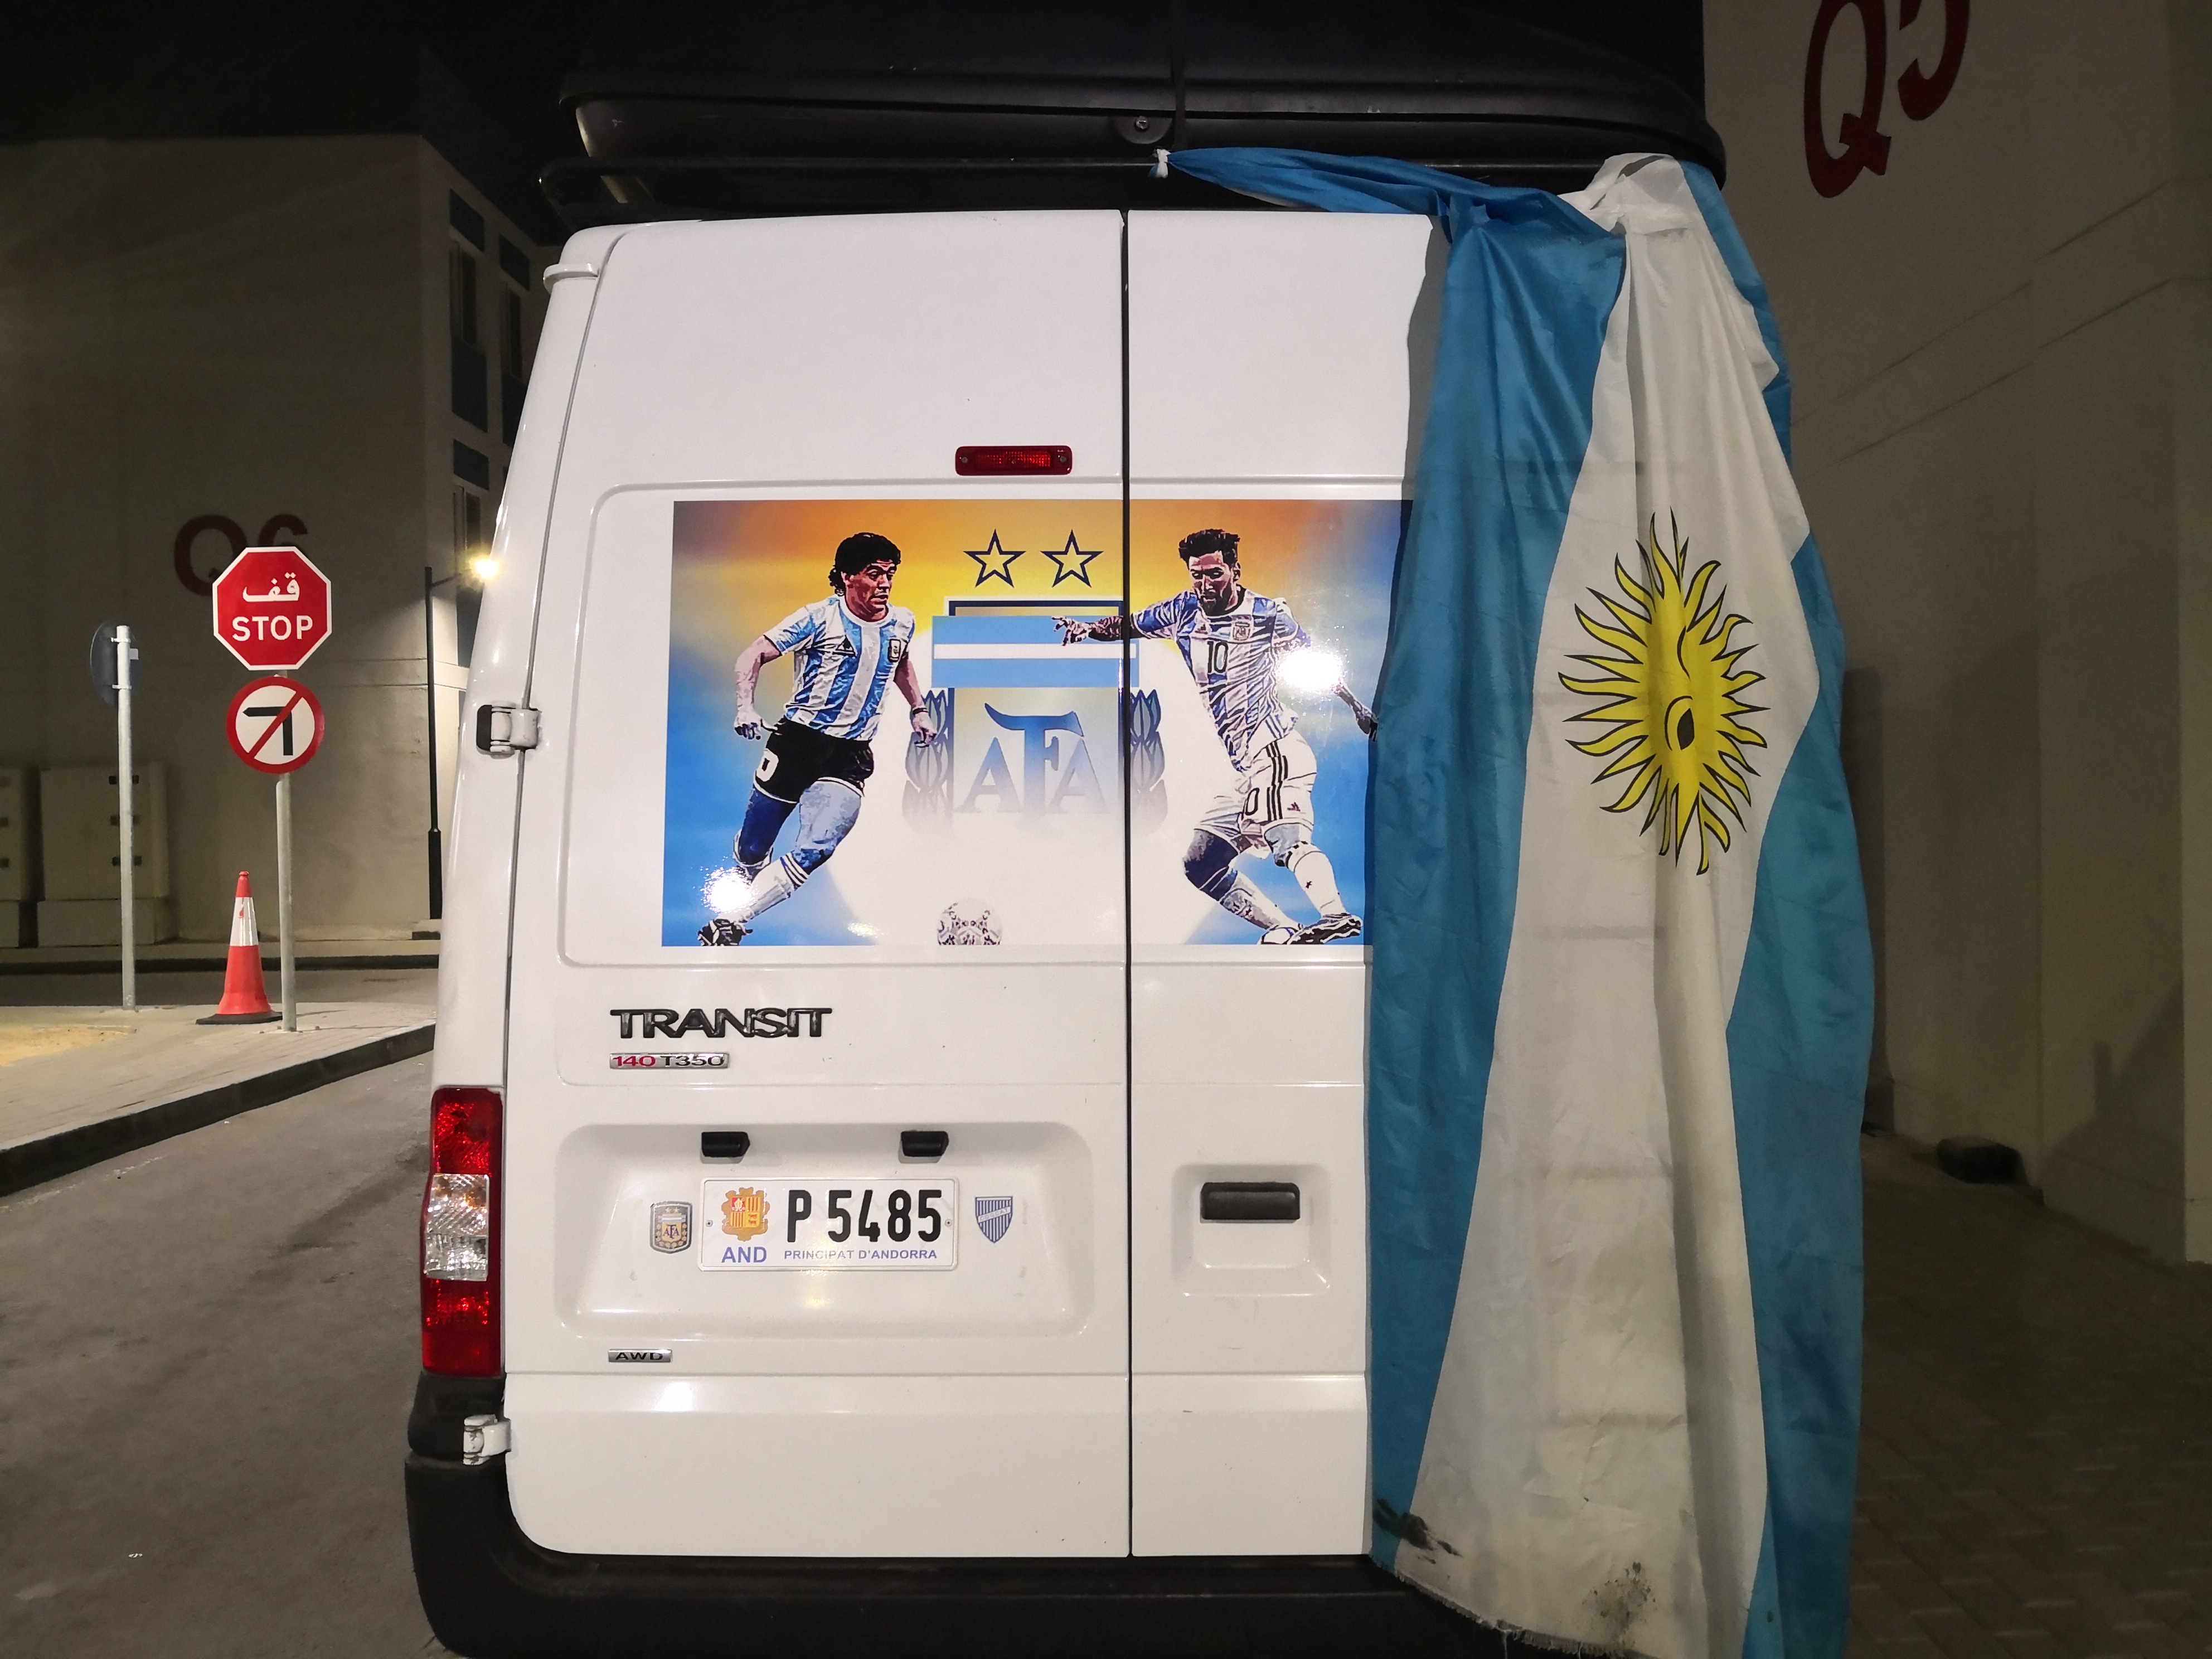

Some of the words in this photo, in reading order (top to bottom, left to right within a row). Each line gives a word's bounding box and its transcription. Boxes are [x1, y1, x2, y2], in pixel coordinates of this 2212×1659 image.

[242, 571, 300, 603] قف
[232, 615, 313, 642] STOP
[1207, 641, 1229, 673] 10
[958, 702, 1112, 819] AFA
[610, 1007, 833, 1039] TRANSIT
[613, 1055, 656, 1067] 140
[660, 1055, 725, 1067] T350
[787, 1189, 812, 1243] P
[827, 1189, 942, 1243] 5485
[721, 1246, 768, 1264] AND
[784, 1249, 855, 1260] PRINCIPAT
[858, 1249, 938, 1260] D'ANDORRA
[615, 1352, 663, 1360] AWD
